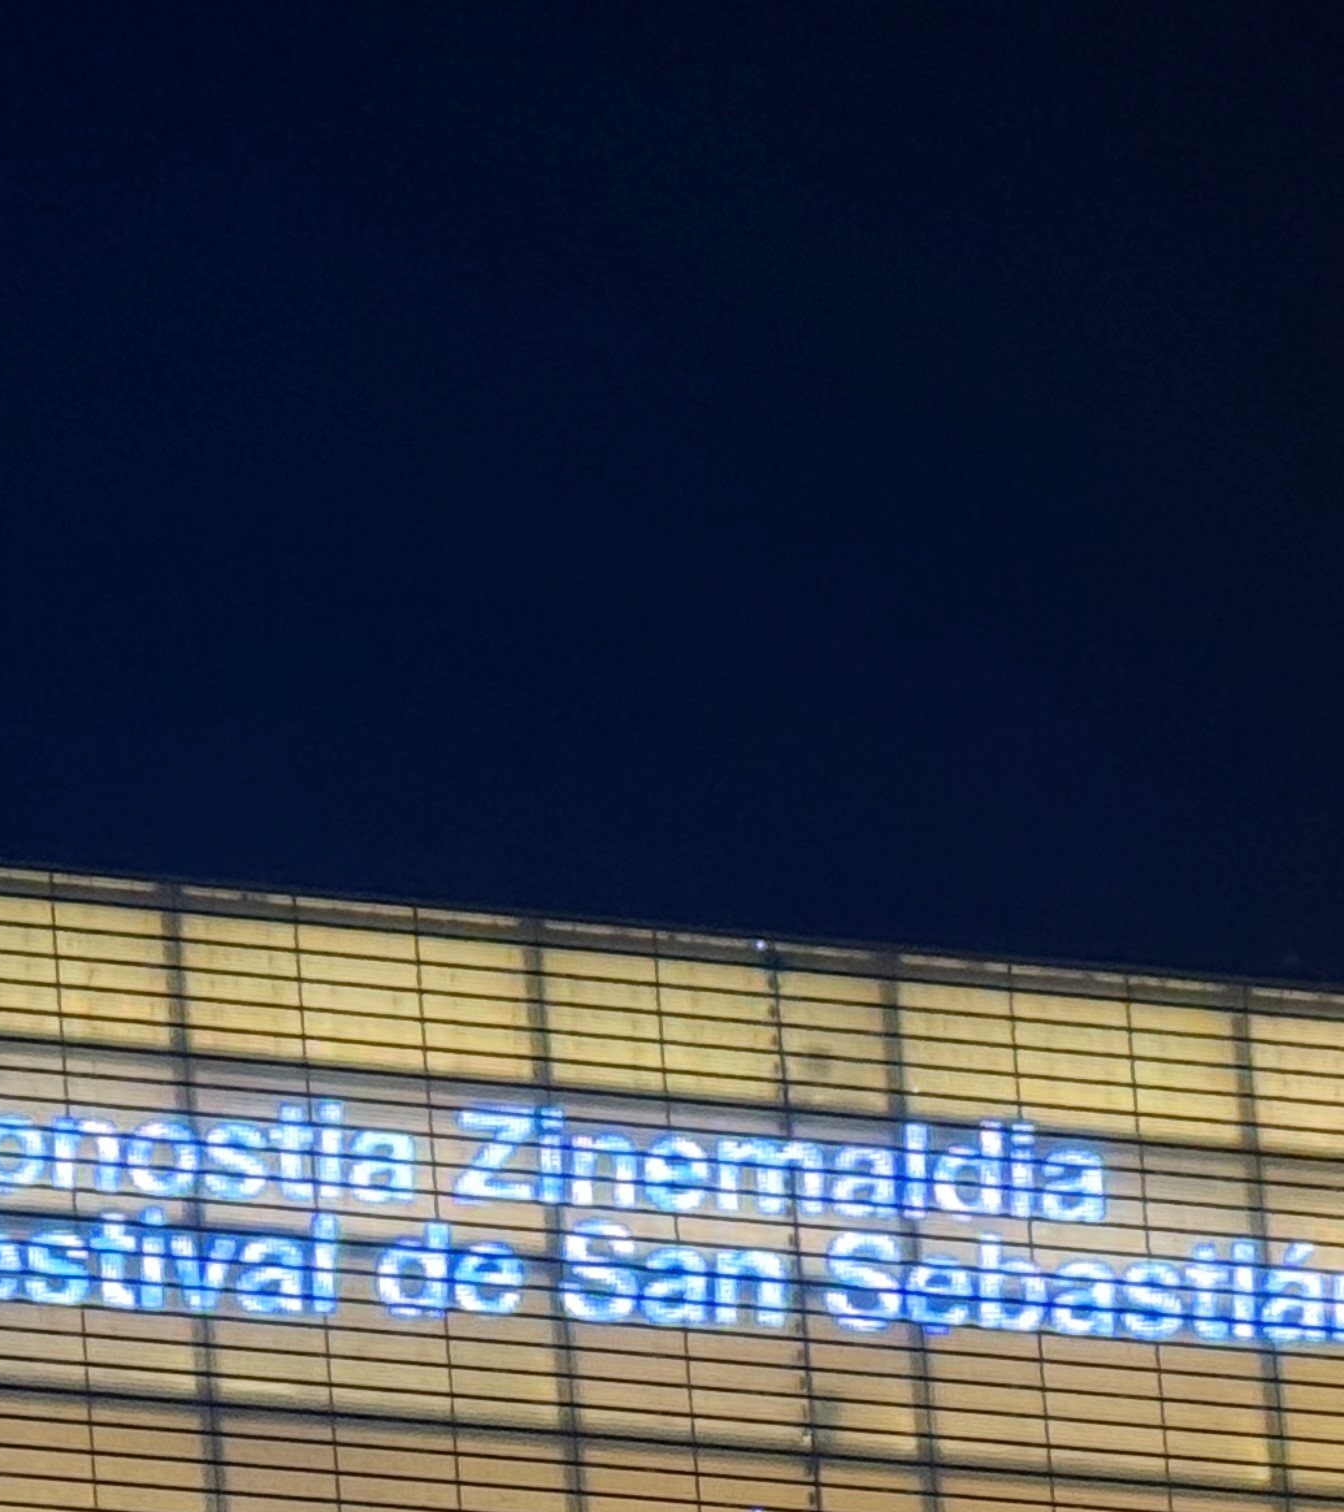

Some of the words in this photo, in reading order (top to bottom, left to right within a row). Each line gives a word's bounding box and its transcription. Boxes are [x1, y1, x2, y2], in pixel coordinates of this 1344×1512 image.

[455, 1101, 1108, 1223] Zinemaldia
[377, 1219, 526, 1318] de
[558, 1217, 790, 1326] San
